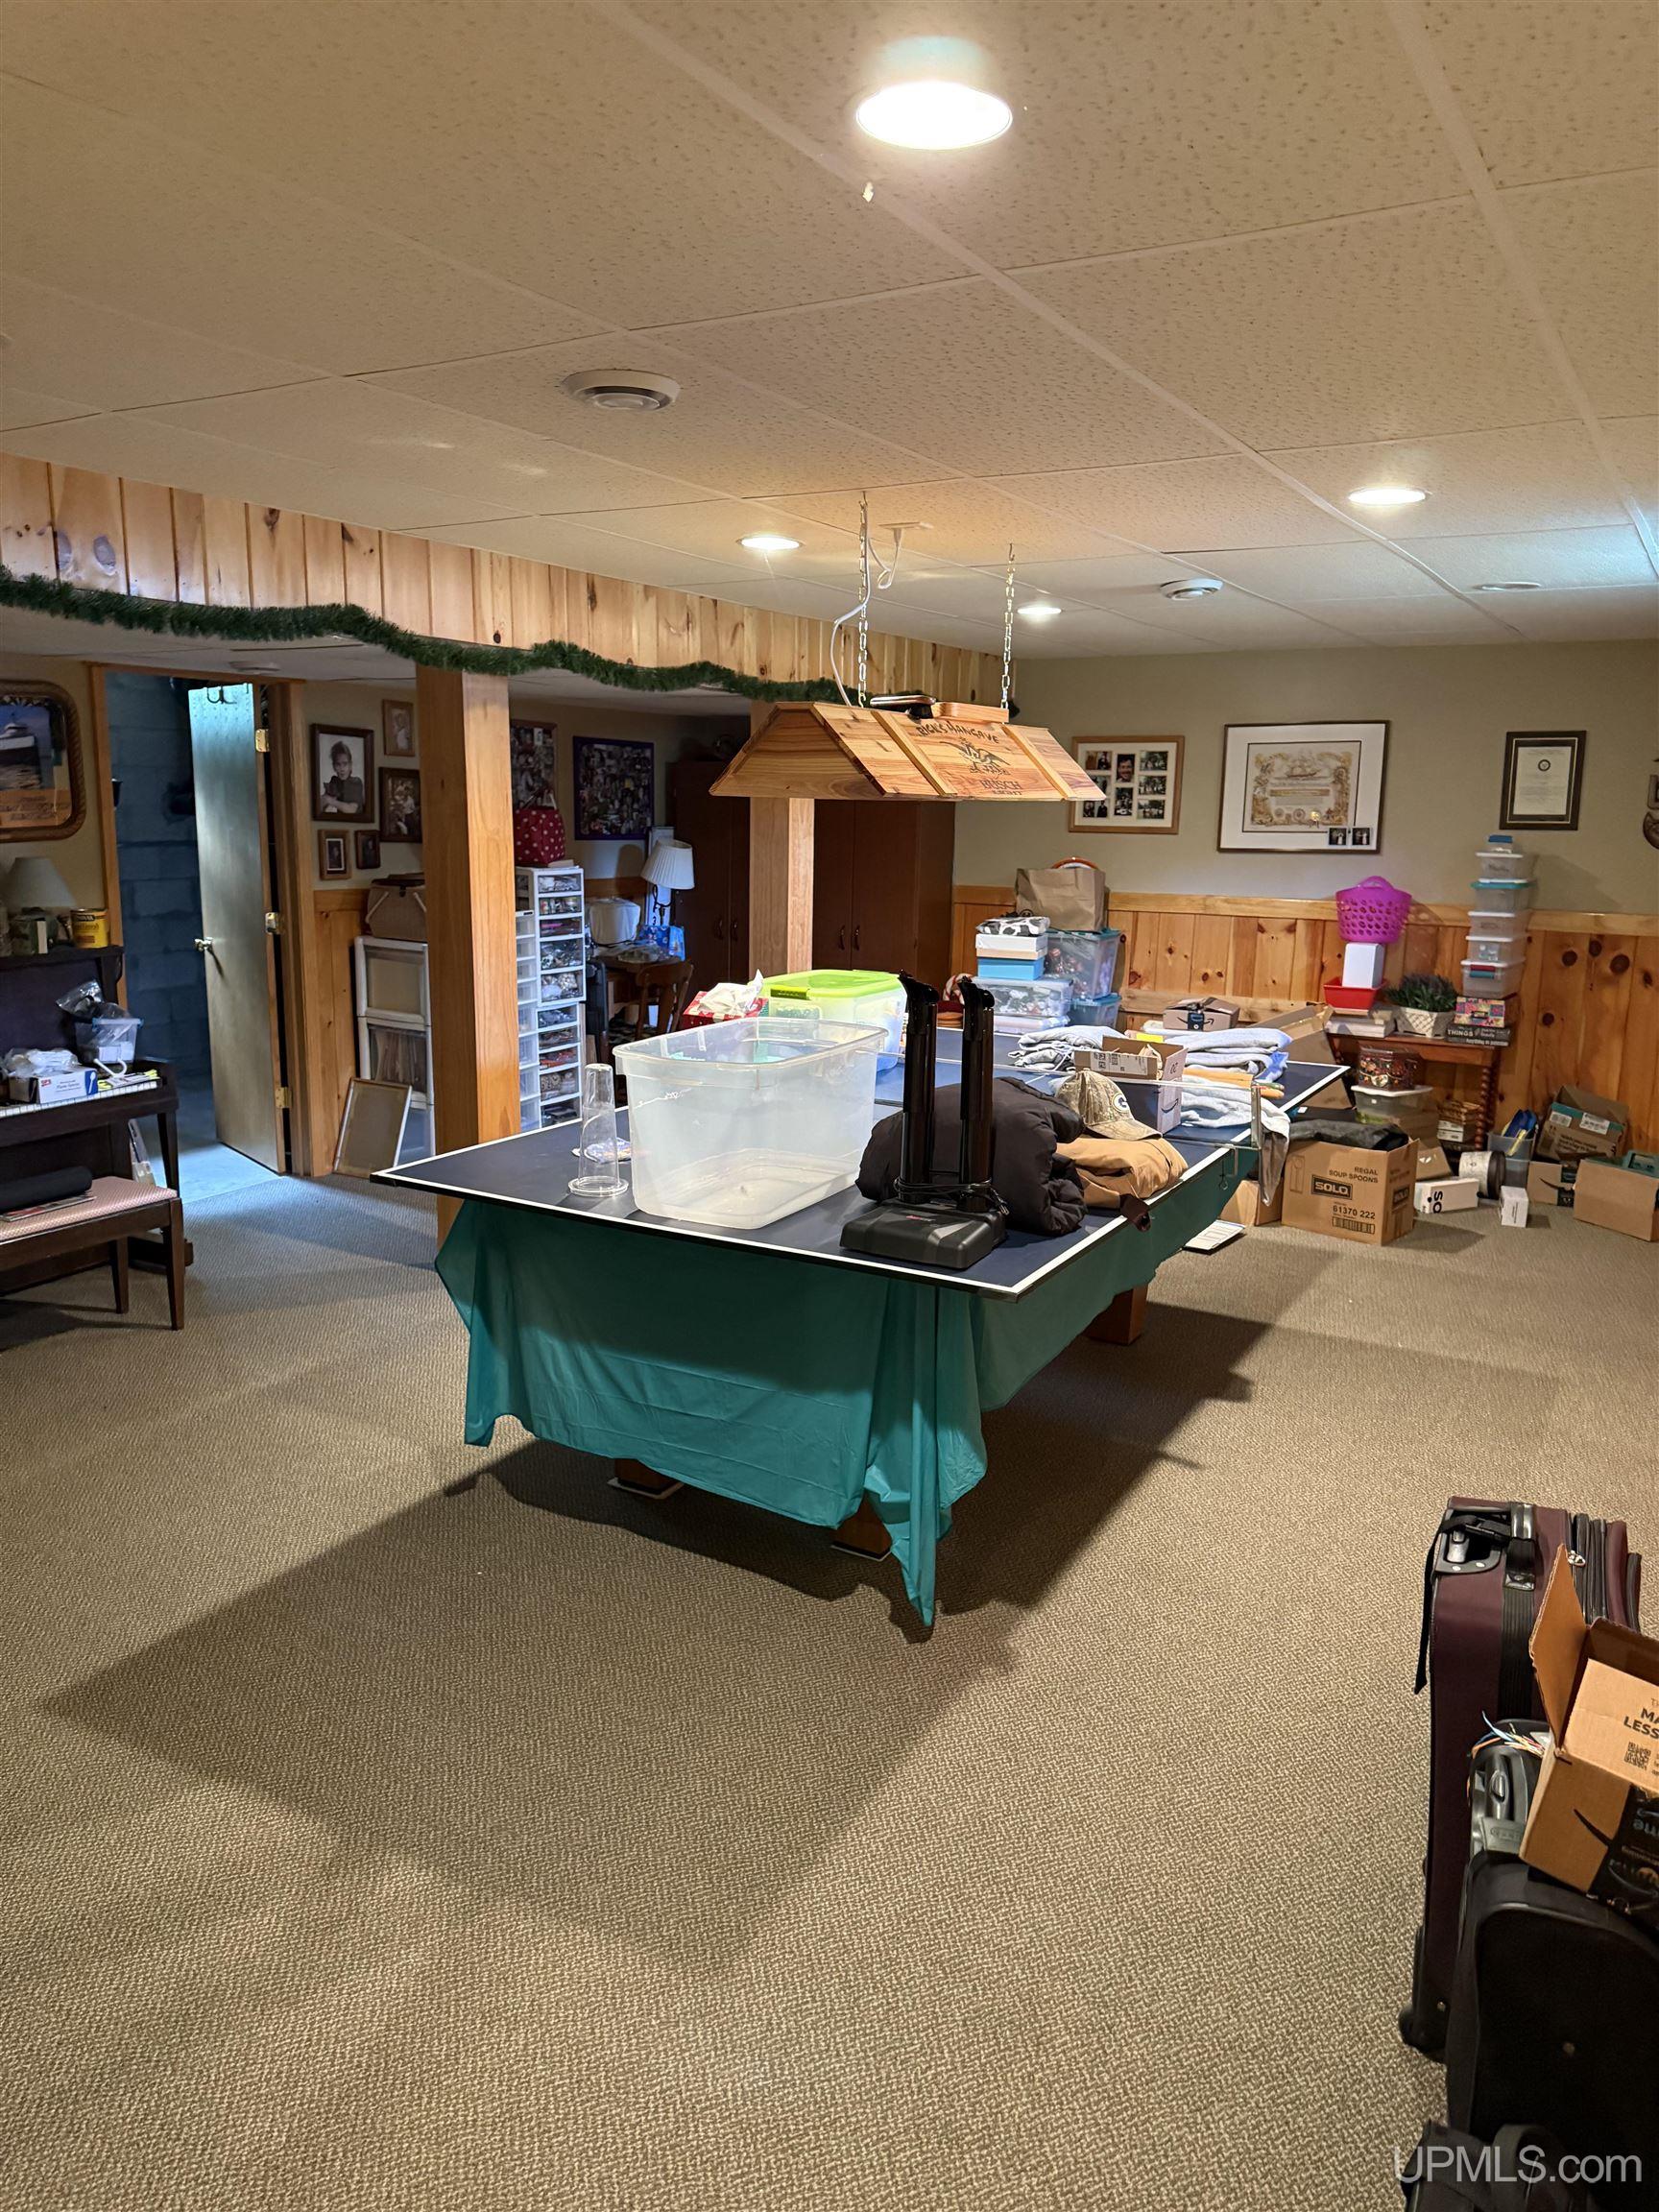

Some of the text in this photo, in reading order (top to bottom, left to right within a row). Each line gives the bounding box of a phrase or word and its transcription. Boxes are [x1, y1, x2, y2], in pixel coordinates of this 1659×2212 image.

[979, 780, 1022, 790] BUSCH
[1447, 1028, 1474, 1037] THINGS
[1354, 1166, 1379, 1176] REGAL
[1329, 1169, 1348, 1178] SOUP
[1348, 1172, 1379, 1184] SPOONS
[1314, 1181, 1349, 1194] SOLO
[1359, 1210, 1376, 1220] 222
[1623, 1715, 1659, 1740] LESS
